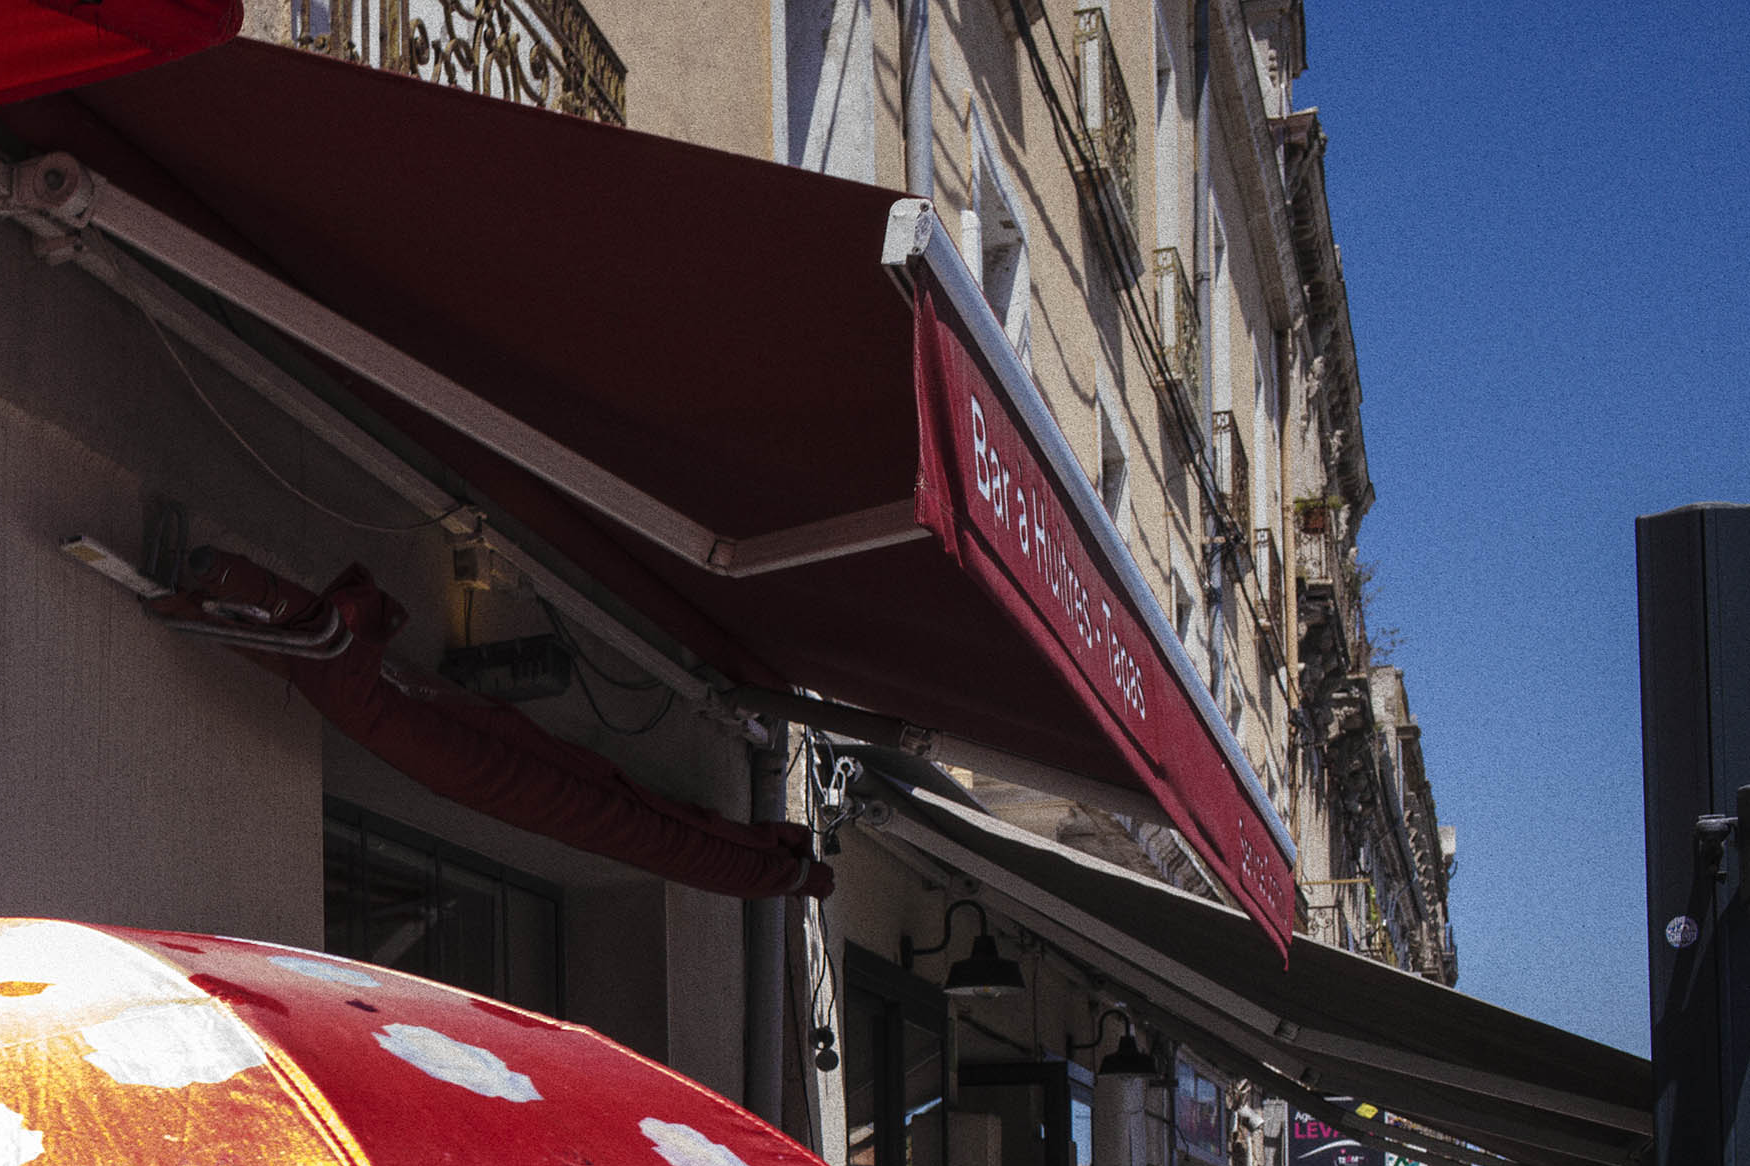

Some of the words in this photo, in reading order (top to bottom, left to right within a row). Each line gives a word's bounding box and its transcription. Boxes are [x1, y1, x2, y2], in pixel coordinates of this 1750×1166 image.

[971, 394, 1009, 530] Bar
[1017, 460, 1030, 558] à
[1102, 598, 1145, 720] Tapas
